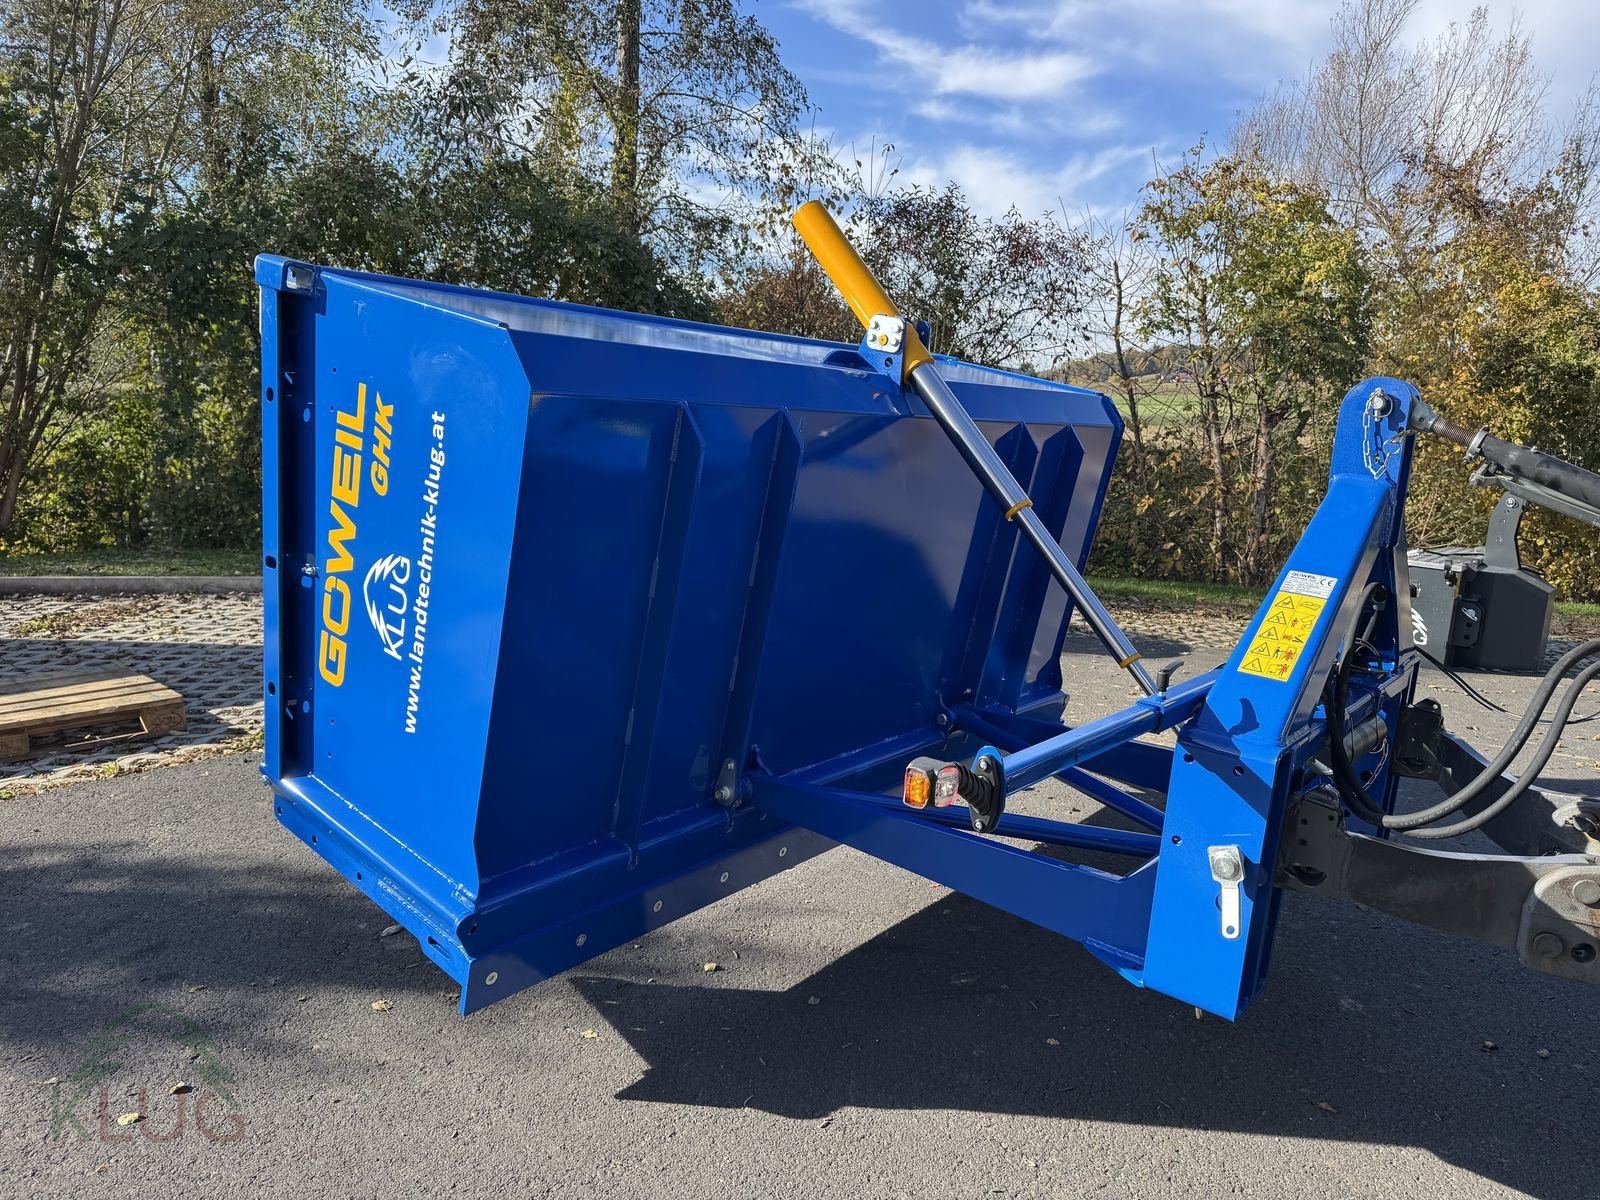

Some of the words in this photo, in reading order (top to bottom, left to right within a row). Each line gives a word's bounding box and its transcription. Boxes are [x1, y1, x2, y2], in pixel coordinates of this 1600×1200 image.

[370, 391, 394, 496] GHK
[383, 555, 411, 661] KLUG
[404, 411, 446, 735] www.landtechnik-klug.at
